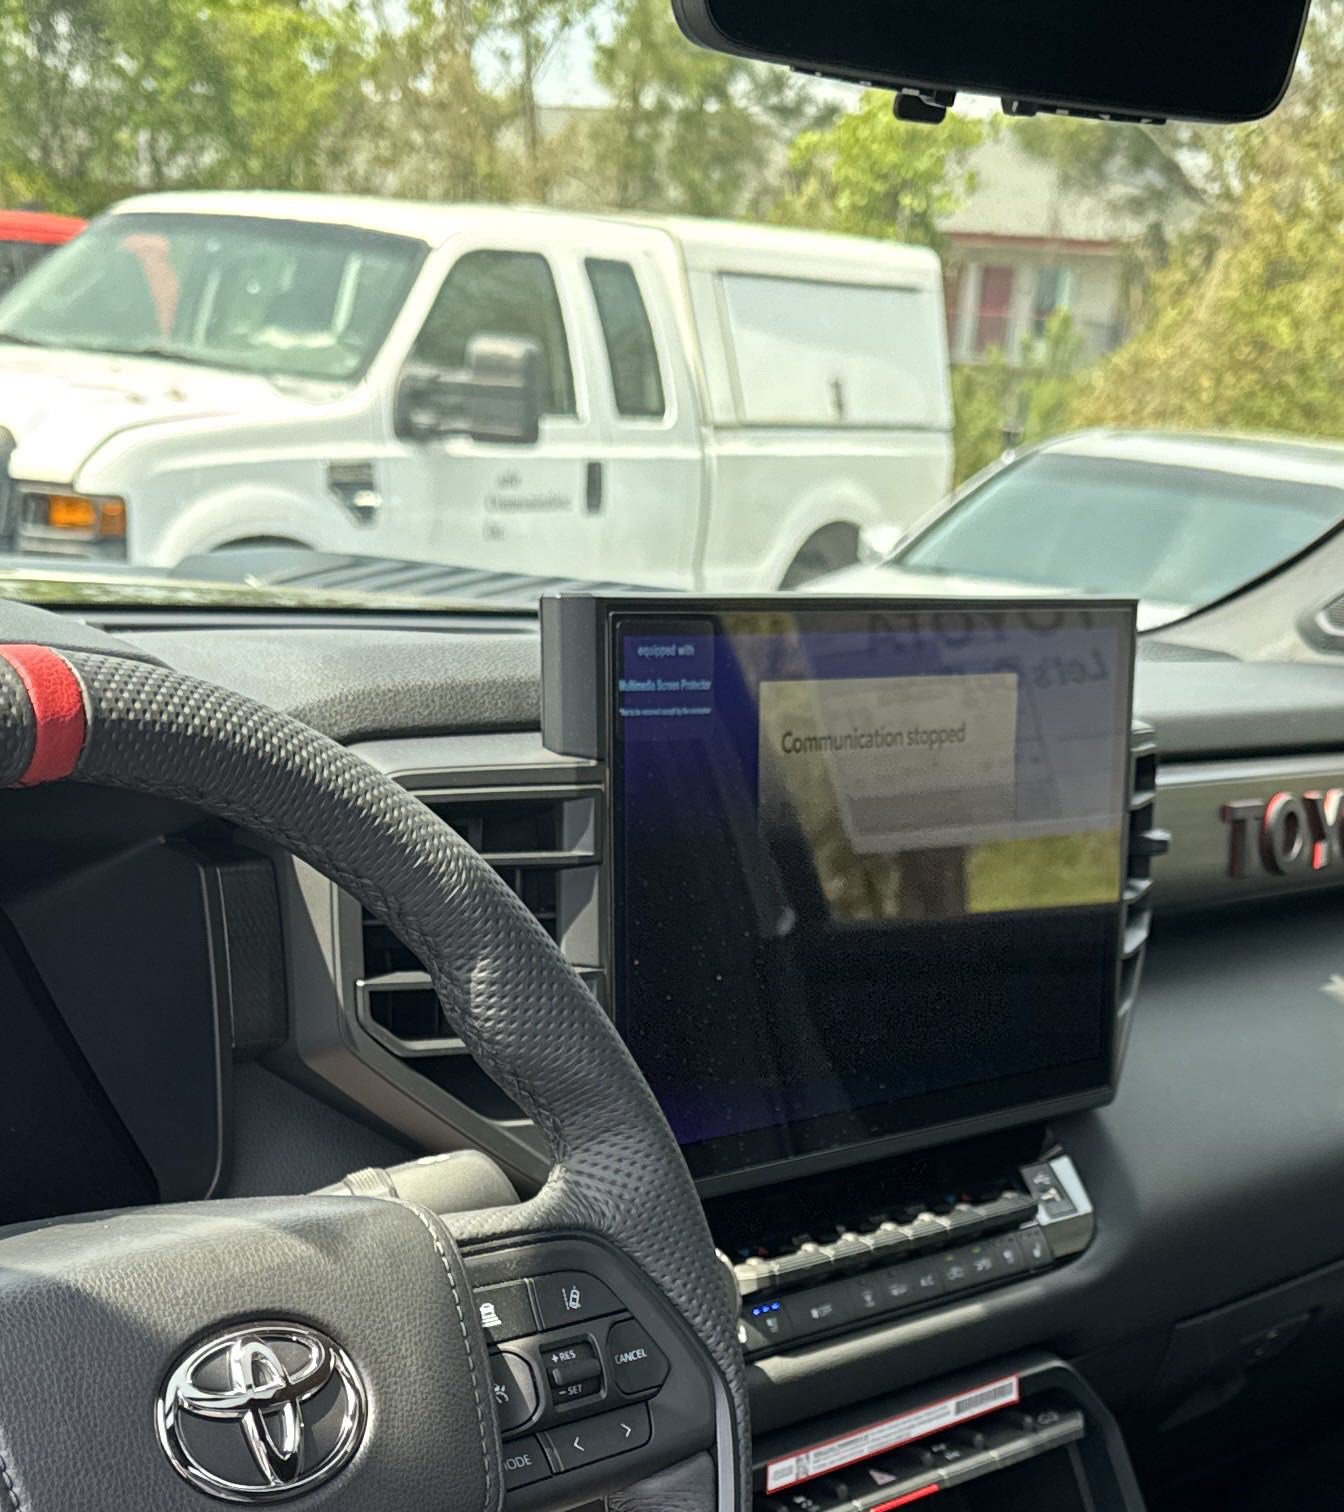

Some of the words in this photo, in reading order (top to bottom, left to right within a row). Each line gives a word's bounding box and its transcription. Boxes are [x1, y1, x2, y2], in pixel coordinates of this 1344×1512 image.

[781, 725, 904, 755] Communication
[907, 720, 967, 750] stopped
[615, 1348, 648, 1366] CANCEL
[503, 1454, 533, 1472] ODE
